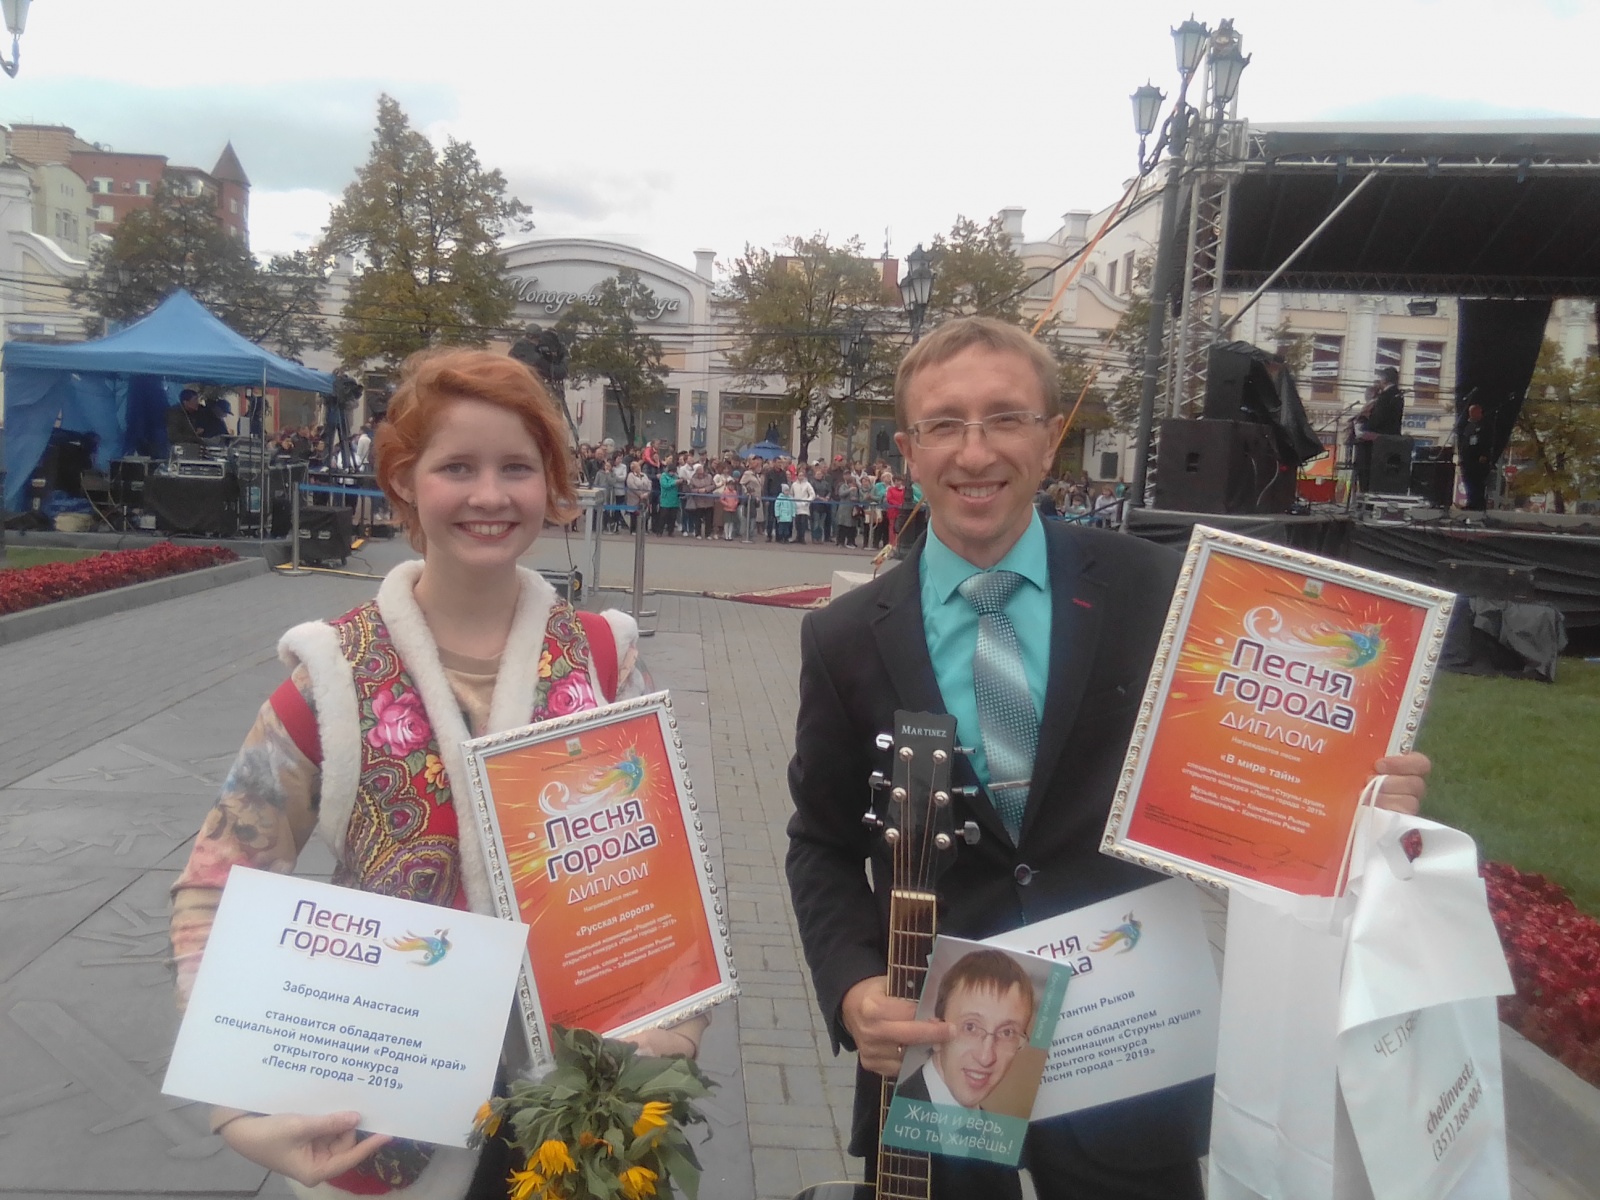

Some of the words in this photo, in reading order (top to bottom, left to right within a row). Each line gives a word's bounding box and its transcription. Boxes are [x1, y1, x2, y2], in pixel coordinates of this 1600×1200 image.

[1231, 637, 1354, 699] Песня
[1214, 671, 1355, 733] города
[1220, 711, 1324, 754] ДИПЛОМ
[1237, 758, 1266, 773] мире
[1269, 767, 1301, 784] тайн»
[545, 799, 644, 850] Песня
[546, 824, 658, 882] города
[567, 863, 649, 905] ДИПЛОМ
[292, 899, 382, 939] Песня
[576, 915, 618, 936] «Русская
[619, 902, 655, 923] дорога»
[278, 927, 383, 966] города
[1026, 935, 1081, 960] сня
[282, 980, 350, 1004] Забродина
[353, 995, 419, 1018] Анастасия
[1058, 1002, 1098, 1021] тантин
[1099, 990, 1136, 1009] Рыков
[214, 1015, 297, 1039] специальной
[299, 1032, 370, 1055] номинации
[373, 1046, 428, 1065] «Родной
[430, 1057, 467, 1072] край»
[265, 1010, 336, 1032] становится
[339, 1025, 422, 1049] обладателем
[1051, 1032, 1084, 1047] вится
[1086, 1008, 1158, 1036] обладателем
[1053, 1035, 1115, 1059] номинации
[1118, 1020, 1166, 1041] «Струны
[1167, 1008, 1202, 1027] души»
[261, 1054, 307, 1073] «Песня
[309, 1065, 354, 1081] города
[367, 1074, 404, 1091] 2019»
[273, 1042, 339, 1064] открытого
[341, 1055, 400, 1075] конкурса
[1044, 1052, 1096, 1072] ткрытого
[1098, 1037, 1148, 1058] конкурса
[1075, 1059, 1114, 1076] города
[1125, 1047, 1156, 1063] 2019»
[894, 1124, 921, 1140] что
[925, 1129, 943, 1143] ты
[945, 1132, 1014, 1155] живёшь!
[904, 1103, 949, 1125] Живи
[951, 1114, 963, 1126] и
[966, 1117, 1005, 1137] верь,
[1432, 1122, 1457, 1162] (351)
